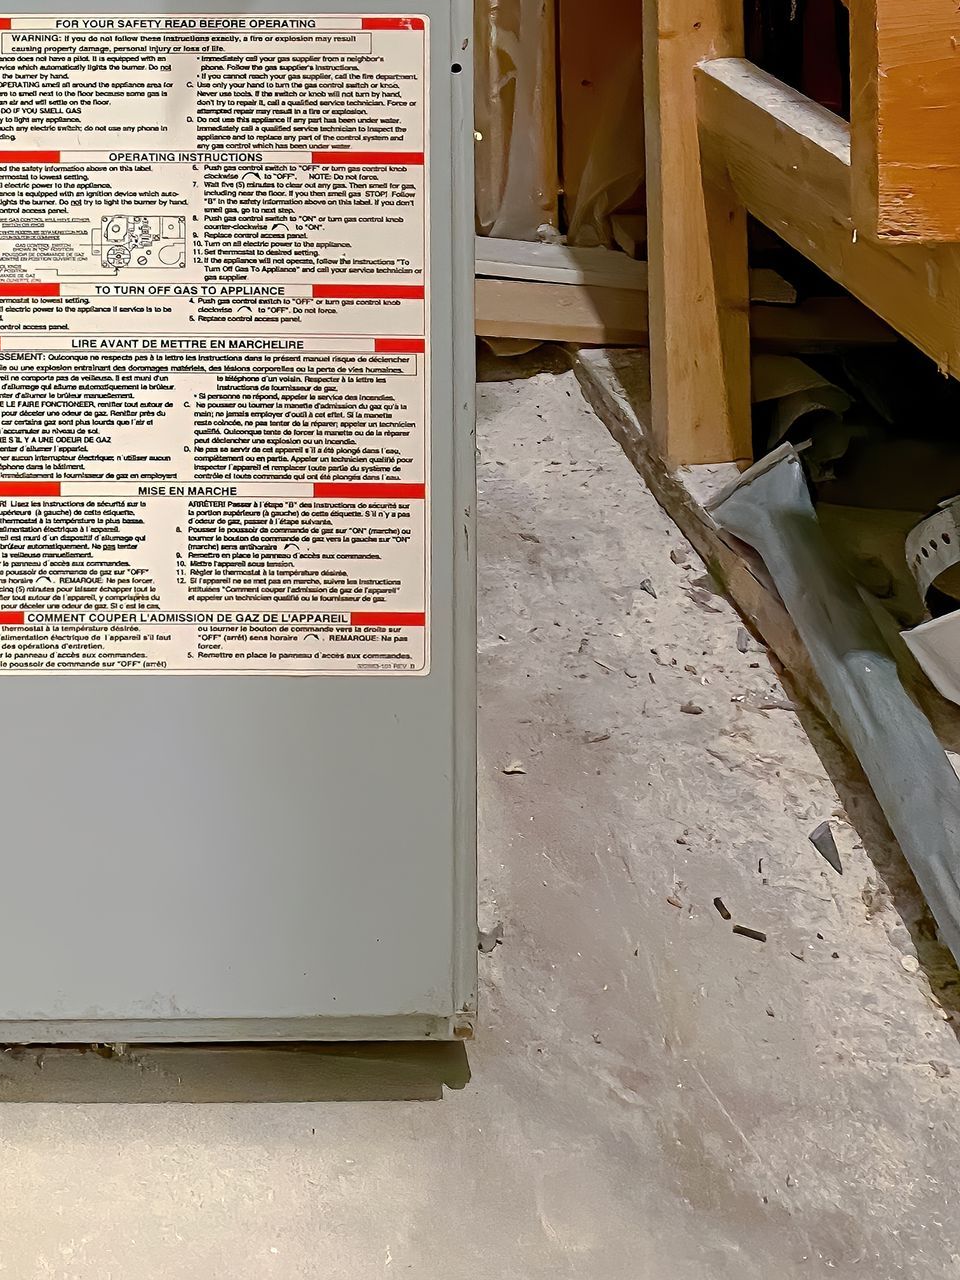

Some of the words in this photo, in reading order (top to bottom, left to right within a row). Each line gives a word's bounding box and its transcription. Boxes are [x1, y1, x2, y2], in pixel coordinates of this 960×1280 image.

[55, 20, 79, 29] FOR
[82, 20, 115, 29] YOUR
[117, 20, 162, 29] SAFETY
[164, 20, 196, 29] READ
[199, 20, 246, 29] BEFORE
[249, 20, 316, 29] OPERATING
[109, 153, 176, 162] OPERATING
[178, 153, 263, 162] INSTRUCTIONS
[95, 286, 111, 294] TO
[114, 286, 145, 294] TURN
[148, 286, 171, 294] OFF
[173, 286, 198, 295] GAS
[201, 286, 217, 295] TO
[220, 287, 285, 295] APPLIANCE
[71, 340, 97, 348] LIRE
[100, 339, 139, 348] AVANT
[142, 340, 158, 348] DE
[160, 340, 207, 348] METTRE
[210, 340, 226, 348] EN
[228, 340, 305, 349] MARCHELIRE
[138, 487, 166, 496] MISE
[169, 487, 185, 496] EN
[187, 487, 237, 496] MARCHE
[27, 614, 85, 622] COMMENT
[88, 614, 137, 622] COUPER
[140, 614, 214, 622] L'ADMISSION
[216, 614, 233, 622] DE
[235, 614, 260, 622] GAZ
[262, 614, 279, 622] DE
[281, 614, 349, 623] L'APPAREIL
